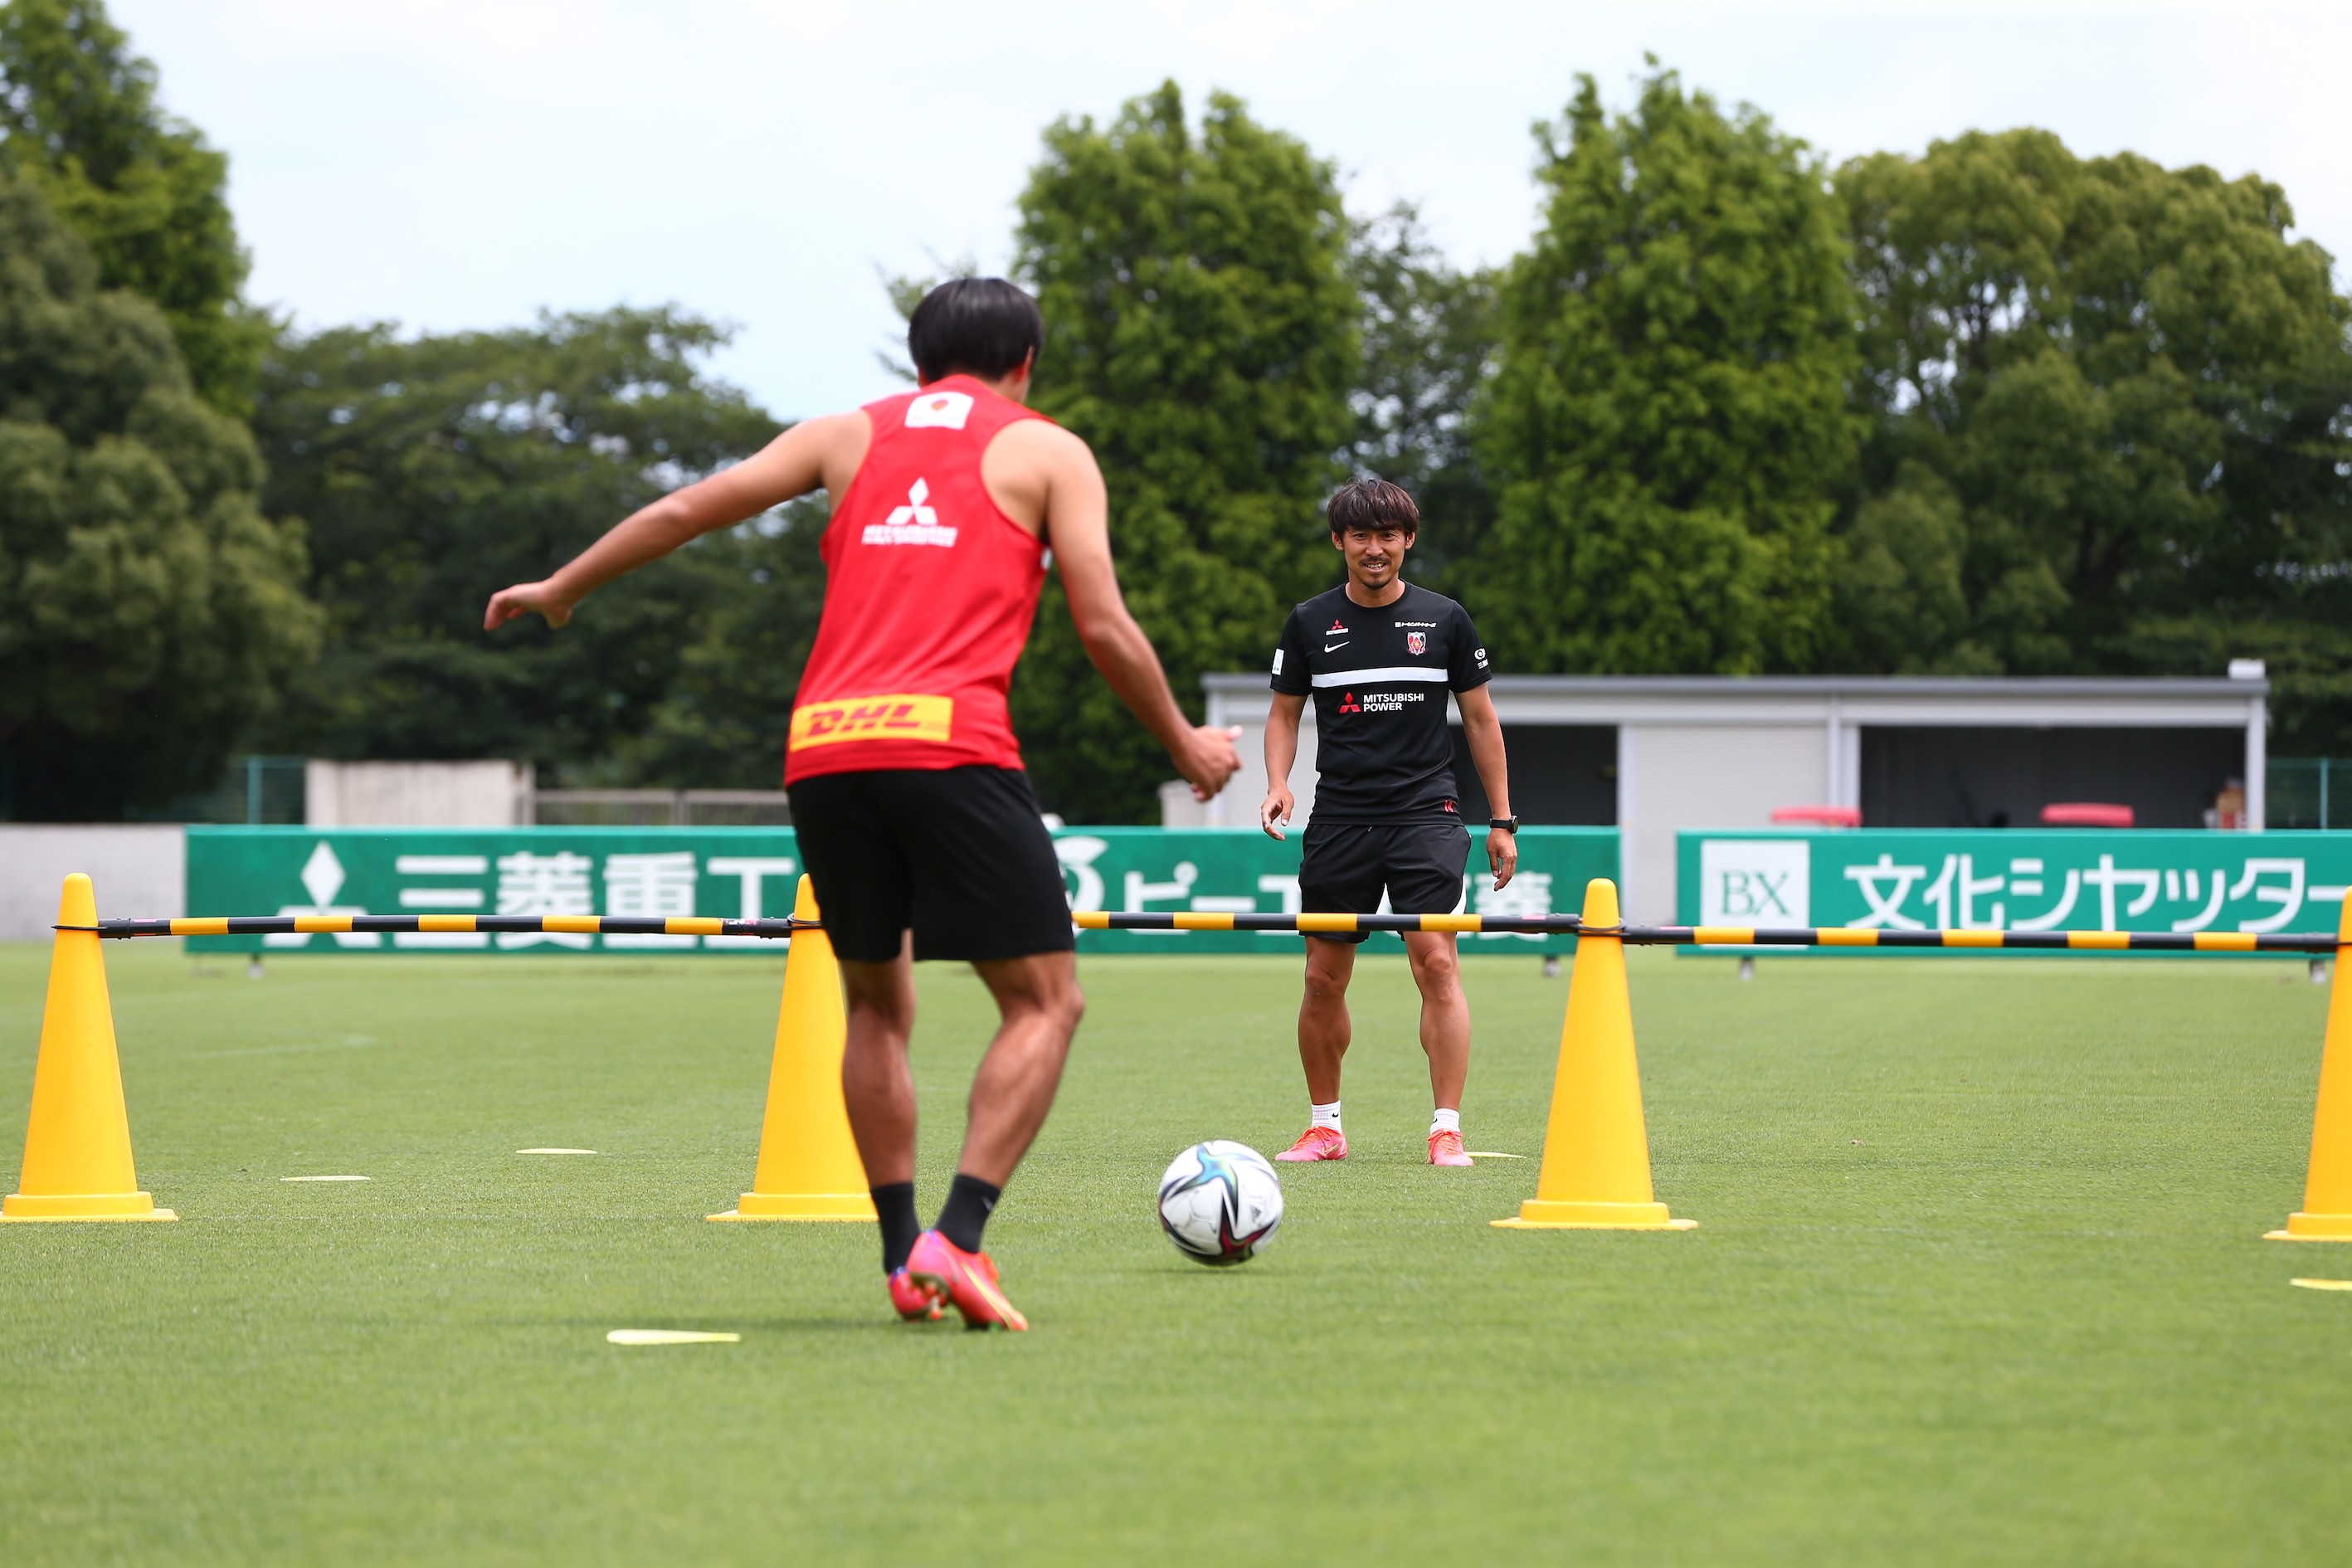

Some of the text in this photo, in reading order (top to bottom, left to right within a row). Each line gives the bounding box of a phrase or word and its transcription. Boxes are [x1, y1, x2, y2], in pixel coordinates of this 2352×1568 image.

[1363, 693, 1424, 704] MITSUBISHI
[1363, 702, 1403, 713] POWER
[807, 704, 920, 737] DHL
[394, 850, 796, 949] 三菱重工
[1720, 869, 1791, 917] BX
